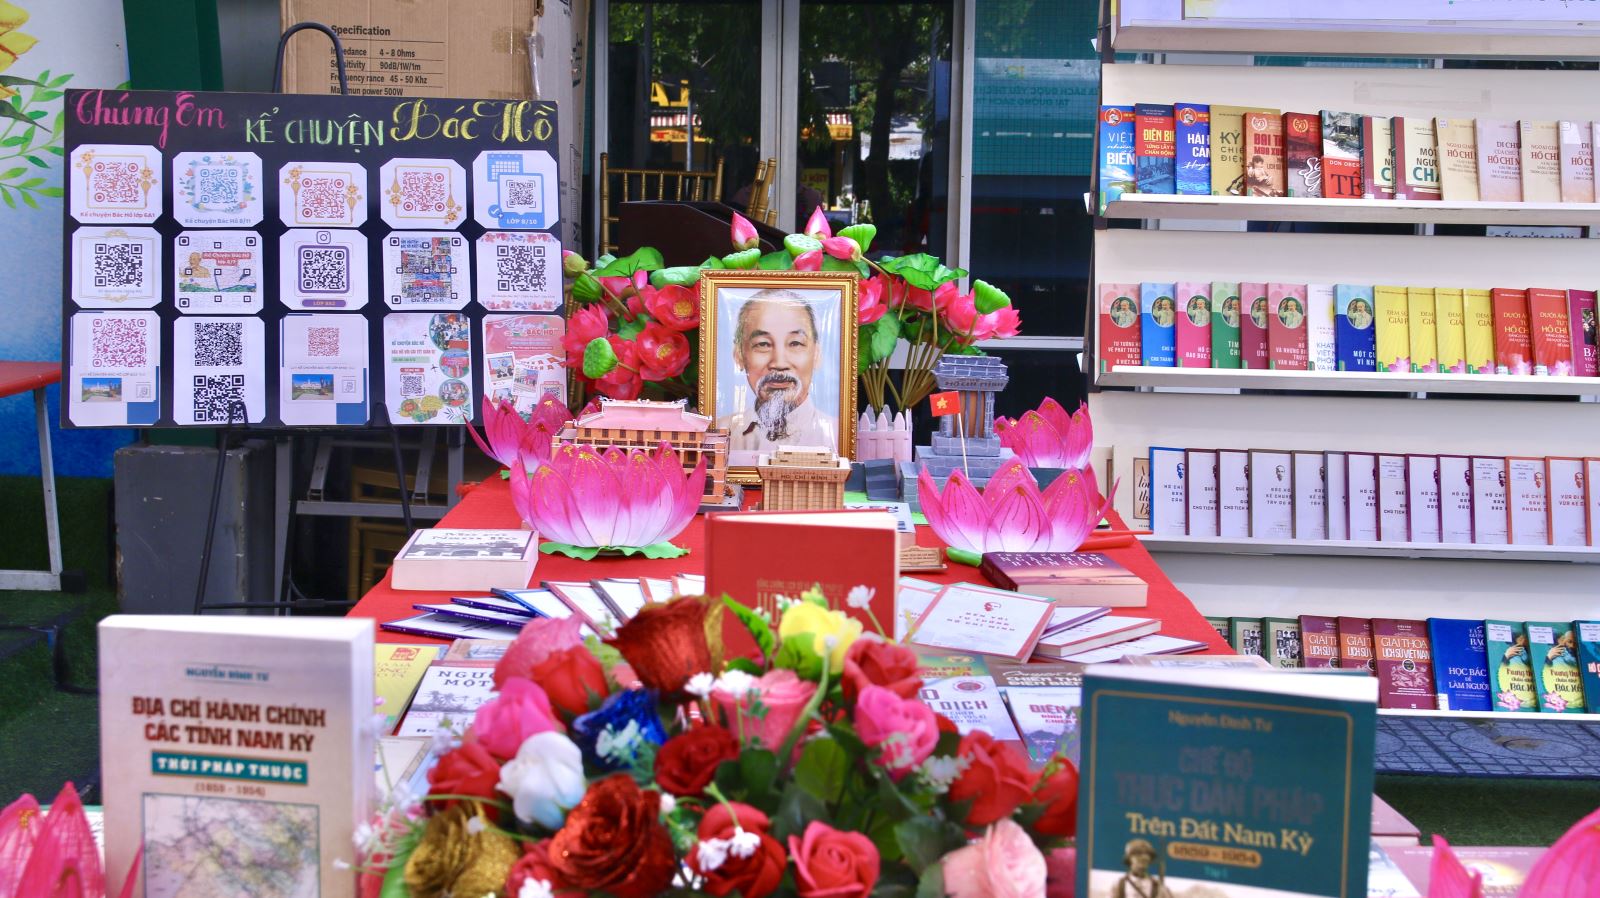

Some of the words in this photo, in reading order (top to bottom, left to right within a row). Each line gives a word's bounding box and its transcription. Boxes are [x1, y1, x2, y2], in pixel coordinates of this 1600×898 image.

[331, 25, 391, 36] Specification
[397, 49, 415, 57] Ohms
[72, 90, 168, 148] Chúng
[174, 91, 227, 129] Em
[285, 113, 384, 153] CHUYỆN
[390, 99, 479, 142] Bác
[132, 697, 165, 717] ĐỊA
[170, 696, 203, 718] CHÍ
[206, 698, 260, 723] HÀNH
[266, 702, 326, 728] CHÍNH
[144, 720, 181, 742] CÁC
[237, 729, 284, 750] NAM
[157, 756, 197, 772] THỜI
[202, 758, 245, 775] PHÁP
[250, 763, 303, 780] THUỘC
[1126, 812, 1175, 838] Trên
[1180, 816, 1218, 842] Đất
[1223, 824, 1276, 848] Nam
